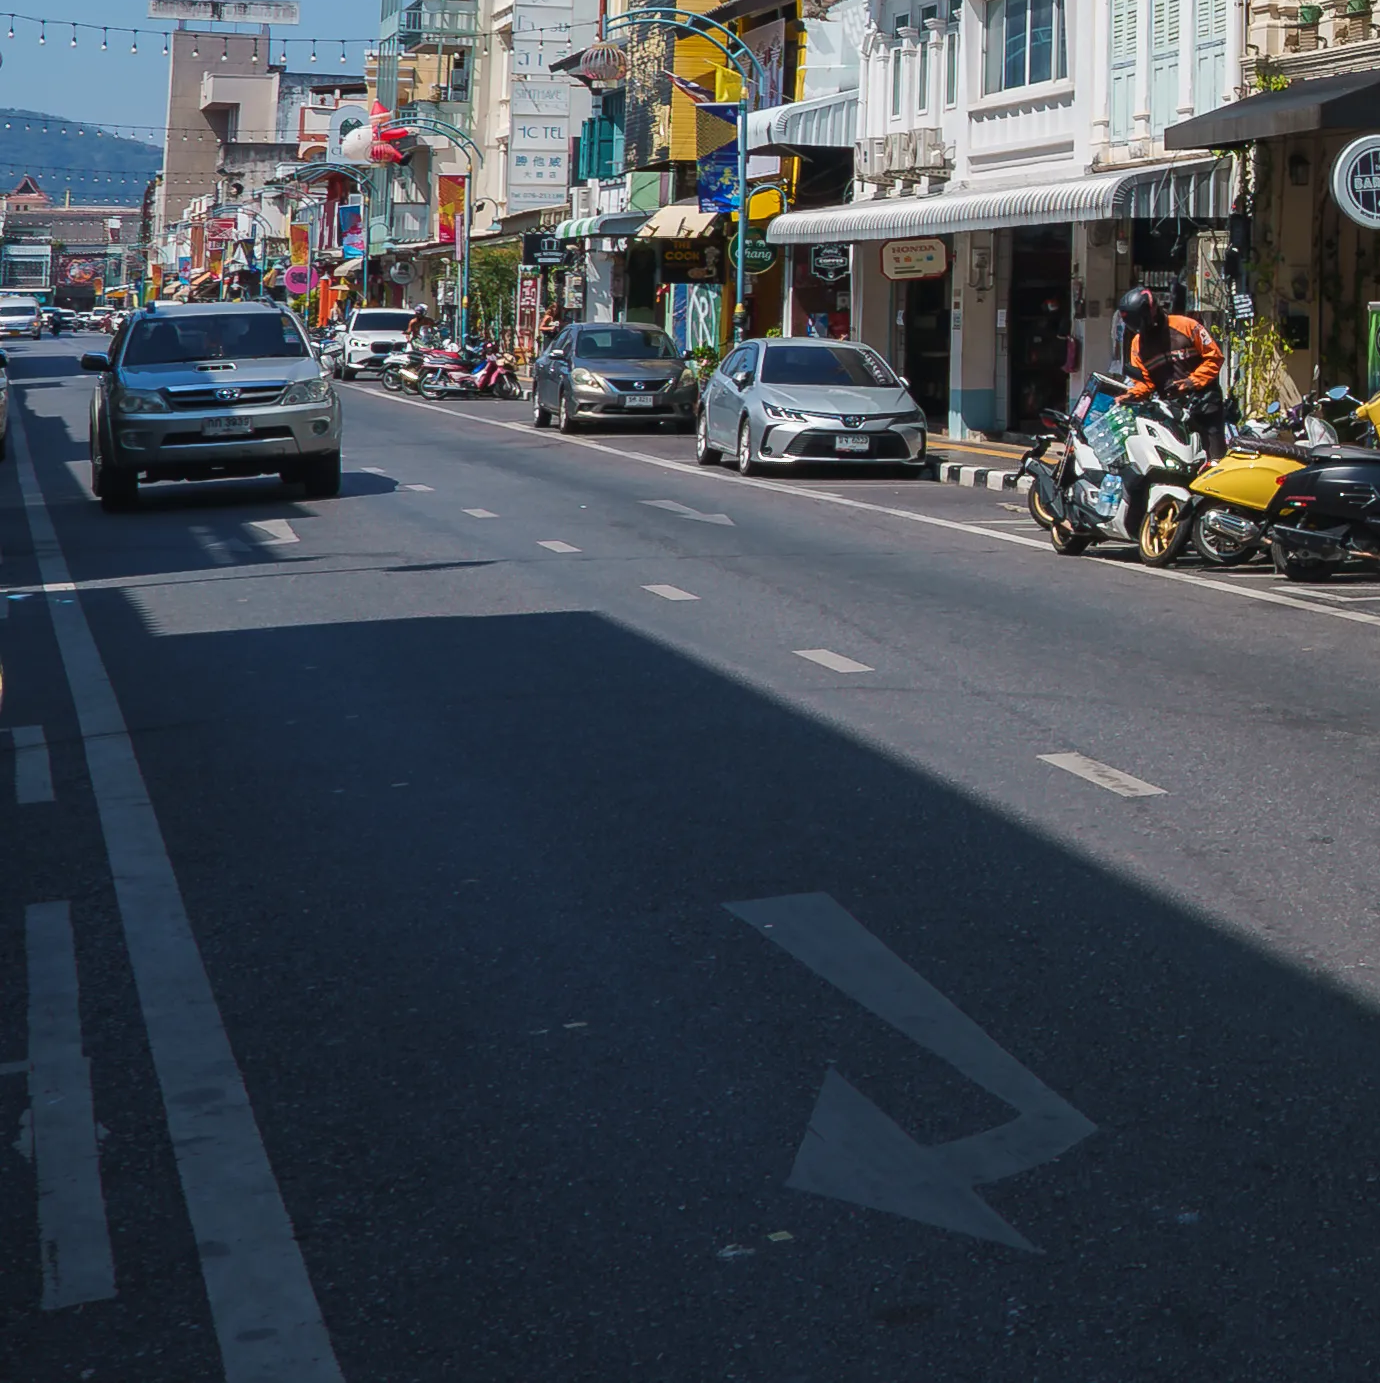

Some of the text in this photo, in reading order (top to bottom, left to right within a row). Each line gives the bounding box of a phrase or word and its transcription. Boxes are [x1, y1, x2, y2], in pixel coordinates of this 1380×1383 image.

[672, 240, 692, 250] THE
[891, 244, 937, 254] HONDA
[663, 250, 701, 261] COOK
